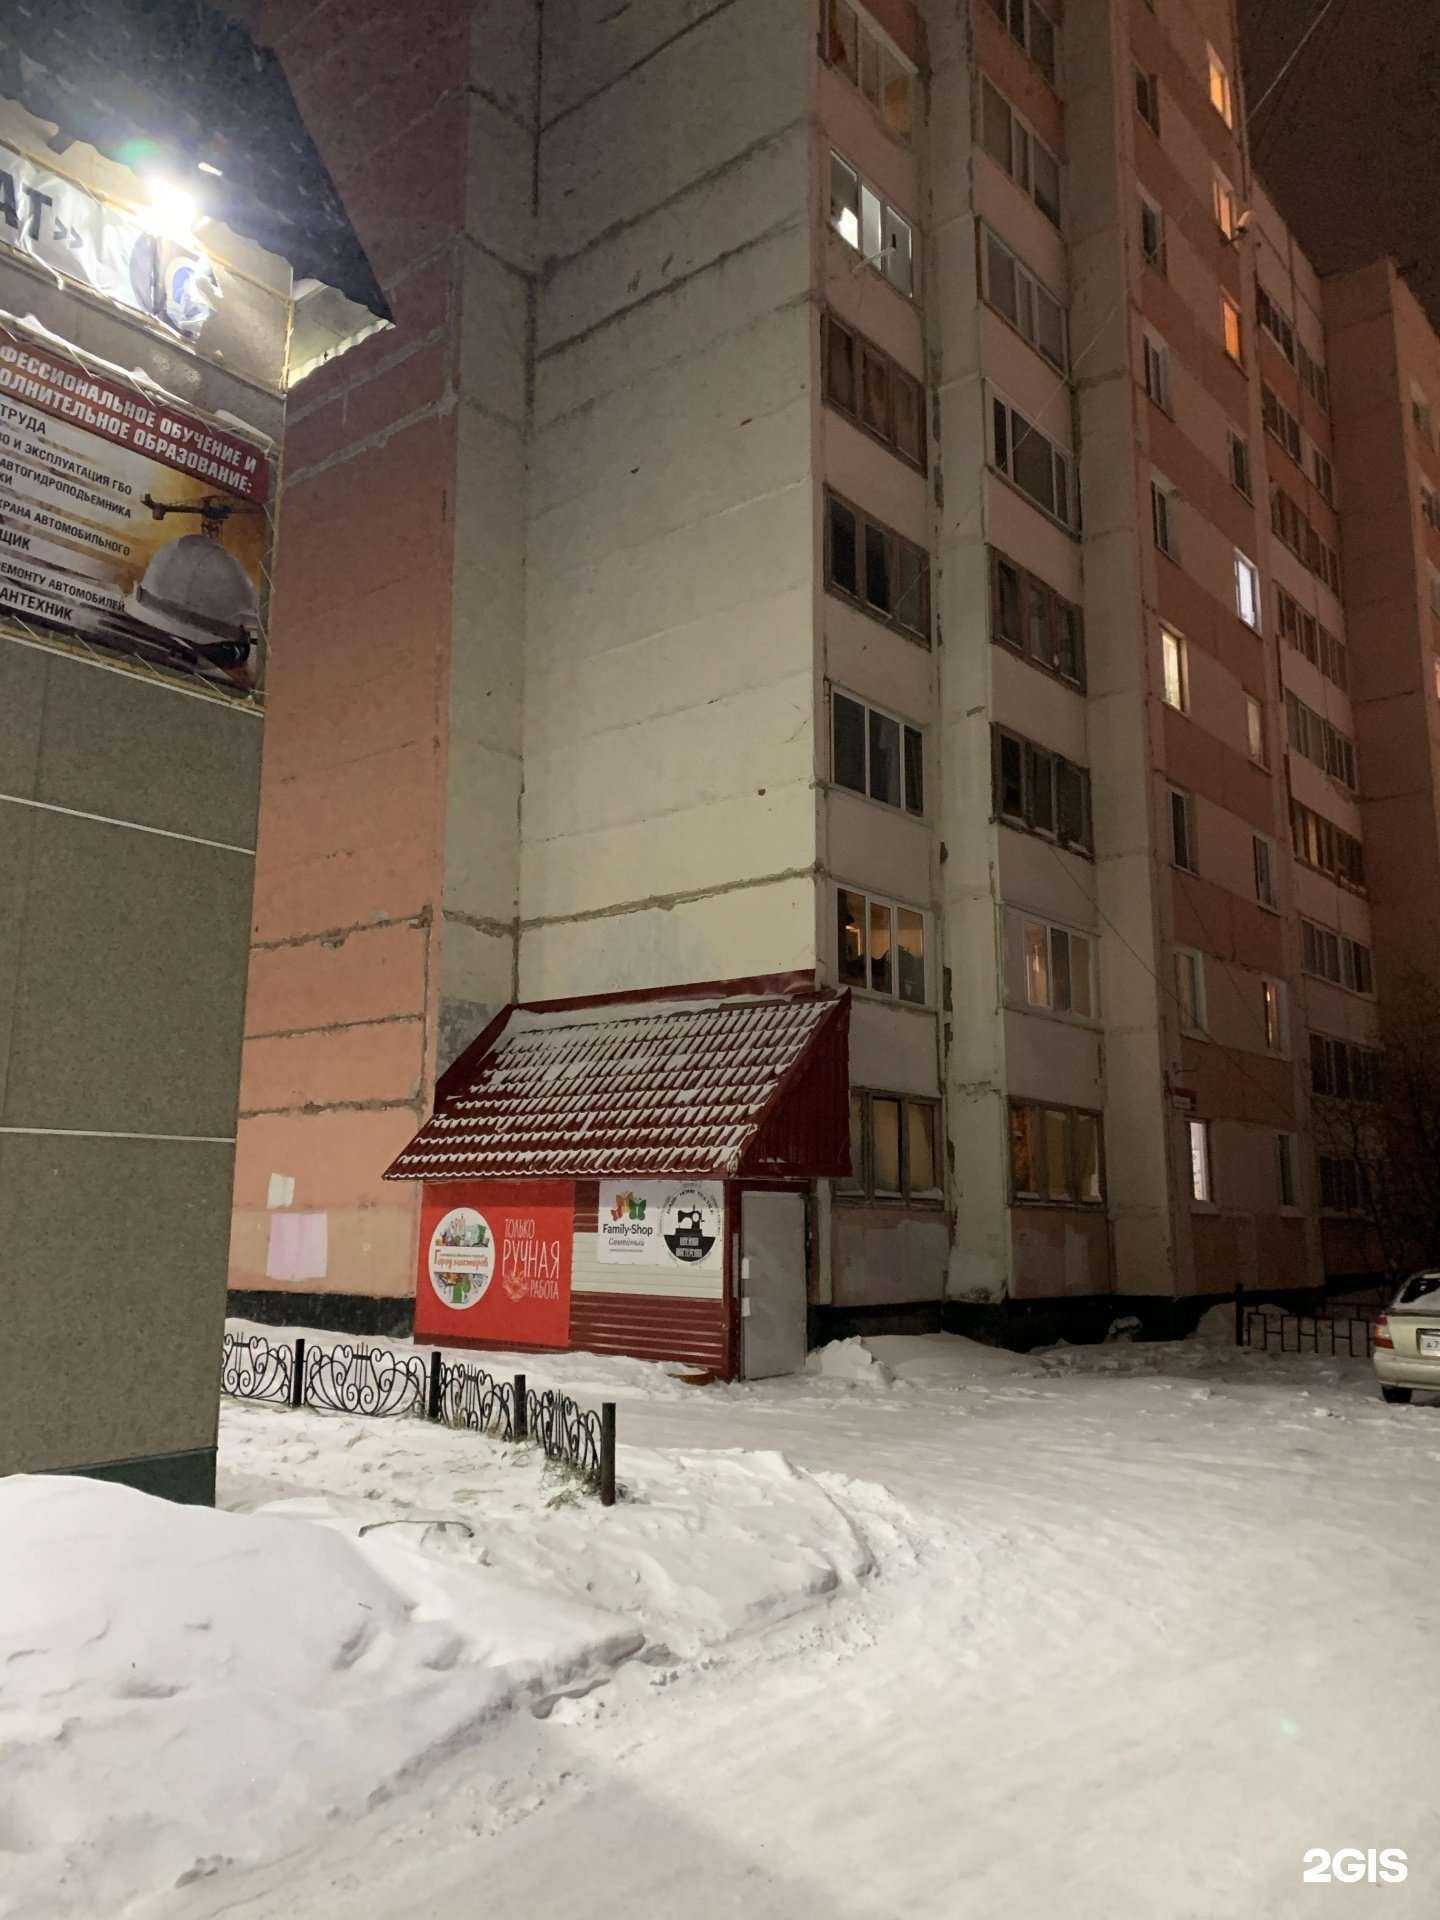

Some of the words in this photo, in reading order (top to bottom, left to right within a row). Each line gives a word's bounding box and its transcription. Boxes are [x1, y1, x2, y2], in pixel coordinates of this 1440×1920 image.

[0, 403, 47, 435] ТРУДА
[133, 428, 253, 494] ОБРАЗОВАНИЕ:
[160, 417, 241, 466] ОБУЧЕНИЕ
[244, 454, 257, 473] И
[13, 438, 22, 450] И
[24, 443, 111, 487] ЭКСПЛУАТАЦИЯ
[112, 478, 132, 495] ГБО
[33, 512, 130, 556] АВТОМОБИЛЬНОГО
[0, 587, 73, 621] АНТЕХНИК
[504, 1217, 535, 1239] ТОЛЬКО
[502, 1239, 560, 1280] РУЧНАЯ
[529, 1280, 560, 1300] РАБОТА
